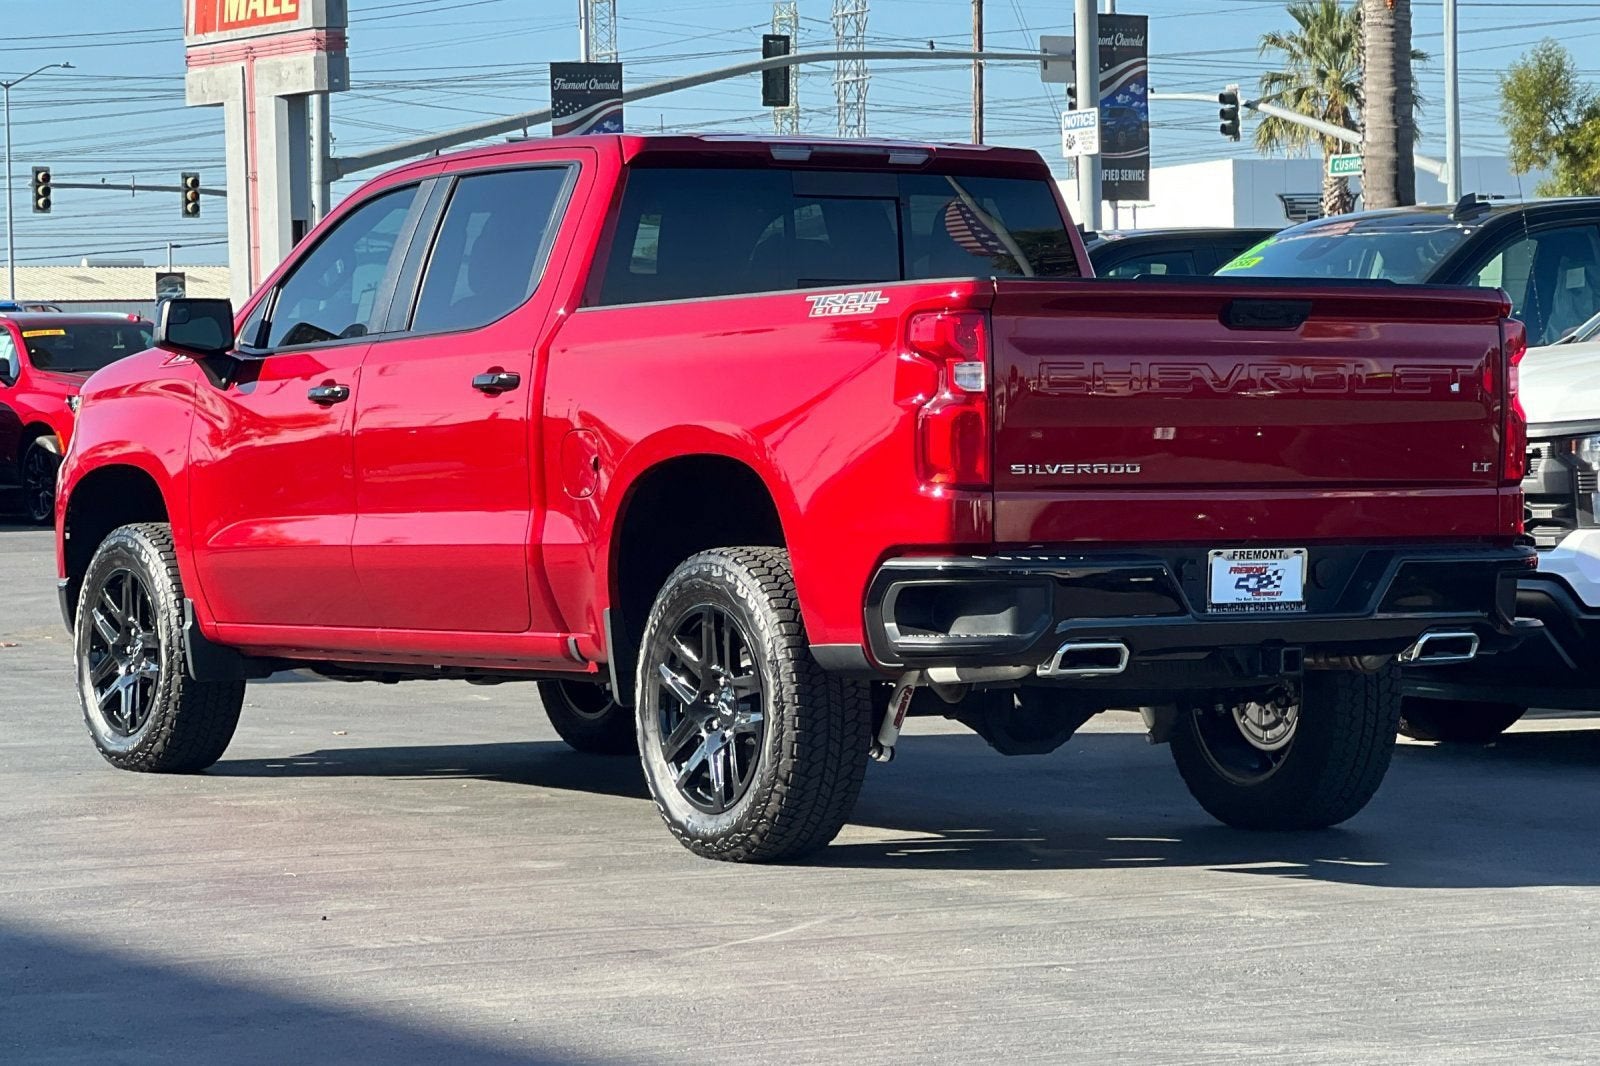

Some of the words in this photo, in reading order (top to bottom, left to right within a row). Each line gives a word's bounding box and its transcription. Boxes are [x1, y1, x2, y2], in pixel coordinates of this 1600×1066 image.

[223, 0, 297, 24] MALL
[1098, 34, 1114, 46] mont
[1114, 32, 1145, 47] Chevrolet
[553, 77, 588, 91] Fremont
[588, 77, 620, 90] Chevrolet
[1064, 112, 1096, 129] NOTICE
[1101, 169, 1120, 181] IFIED
[1120, 169, 1145, 181] SERVICE
[805, 290, 890, 307] TRAIL
[808, 303, 877, 318] BOSS
[1039, 361, 1475, 394] CHEVROLET
[1010, 463, 1141, 475] SILVERADO
[1472, 462, 1493, 472] LT
[1232, 549, 1285, 560] FREMONT
[1229, 566, 1269, 575] FREMONT
